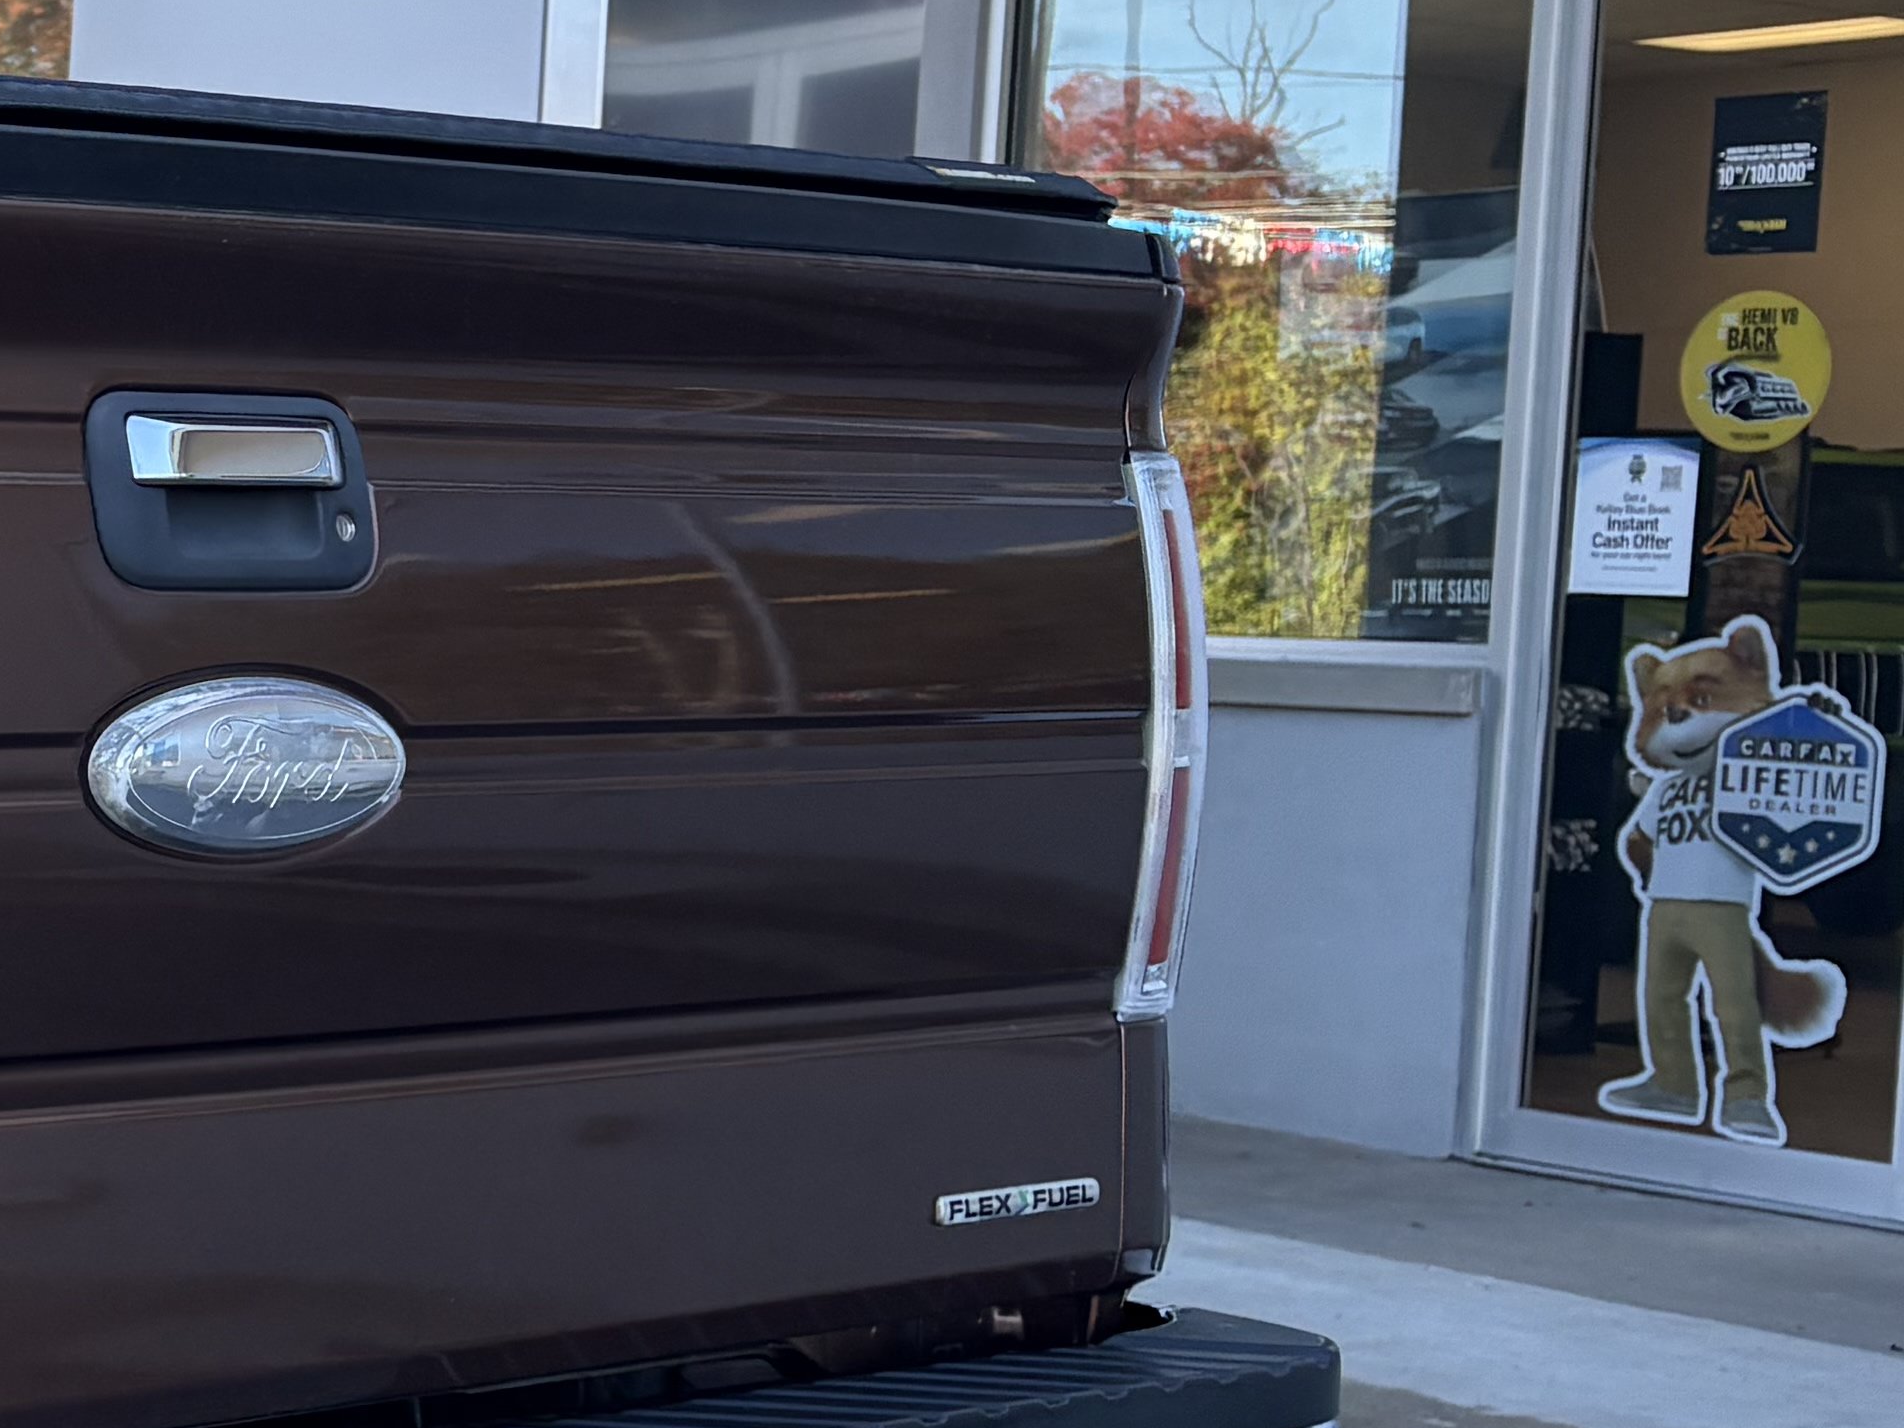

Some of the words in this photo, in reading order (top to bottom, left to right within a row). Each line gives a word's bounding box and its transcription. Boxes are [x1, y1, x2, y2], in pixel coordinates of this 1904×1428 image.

[1742, 308, 1778, 325] HEMI
[1781, 307, 1799, 325] V8
[1727, 326, 1778, 351] BACK
[1607, 516, 1659, 531] Instant
[1592, 532, 1629, 549] Cash
[1633, 533, 1673, 549] Offer
[1392, 578, 1417, 604] IT'S
[1421, 578, 1443, 604] THE
[1740, 739, 1857, 766] CARFAX
[1721, 764, 1868, 804] LIFETIME
[1749, 798, 1837, 816] DEALER
[949, 1193, 1012, 1221] FLEX
[1032, 1184, 1094, 1210] FUEL
